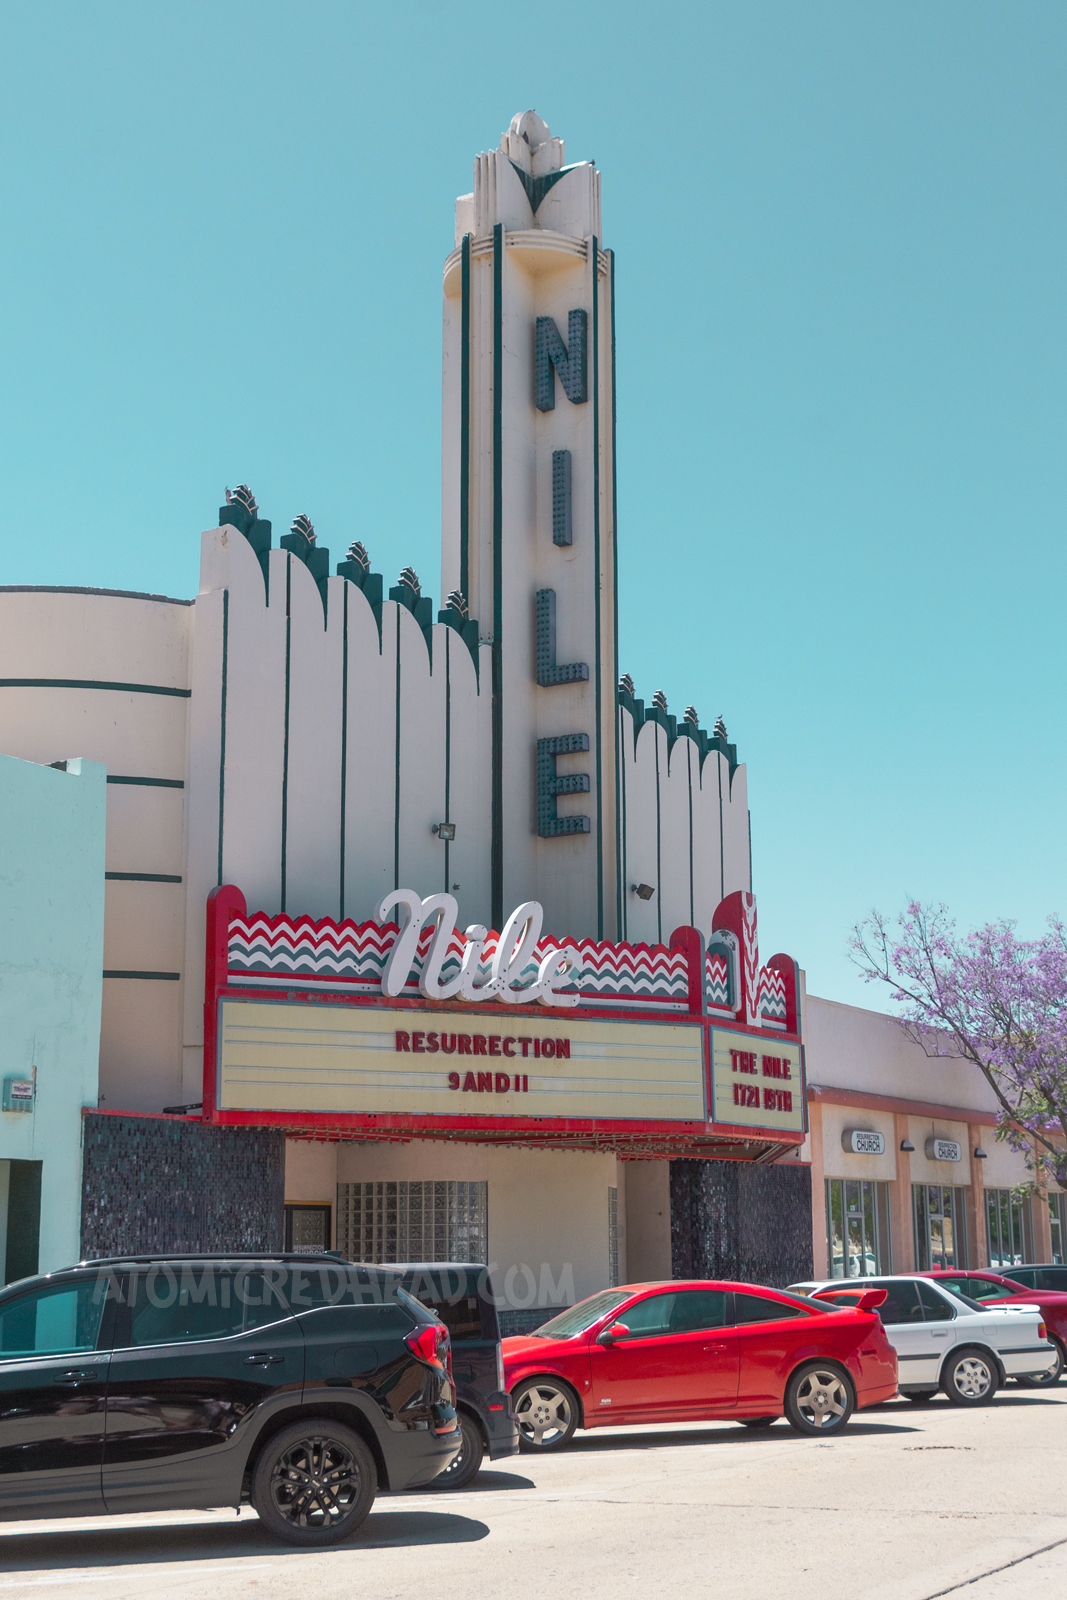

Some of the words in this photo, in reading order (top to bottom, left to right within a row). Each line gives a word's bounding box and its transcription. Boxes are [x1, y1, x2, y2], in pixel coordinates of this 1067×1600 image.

[535, 308, 590, 837] NILE
[395, 1030, 571, 1059] RESURRECTION
[729, 1048, 758, 1075] THE
[762, 1054, 792, 1081] NILE
[448, 1071, 460, 1091] 9
[462, 1071, 511, 1094] AND
[733, 1082, 760, 1109] 1721
[763, 1087, 793, 1113] 19TH
[856, 1140, 881, 1152] CHURCH
[938, 1148, 958, 1159] CHURCH
